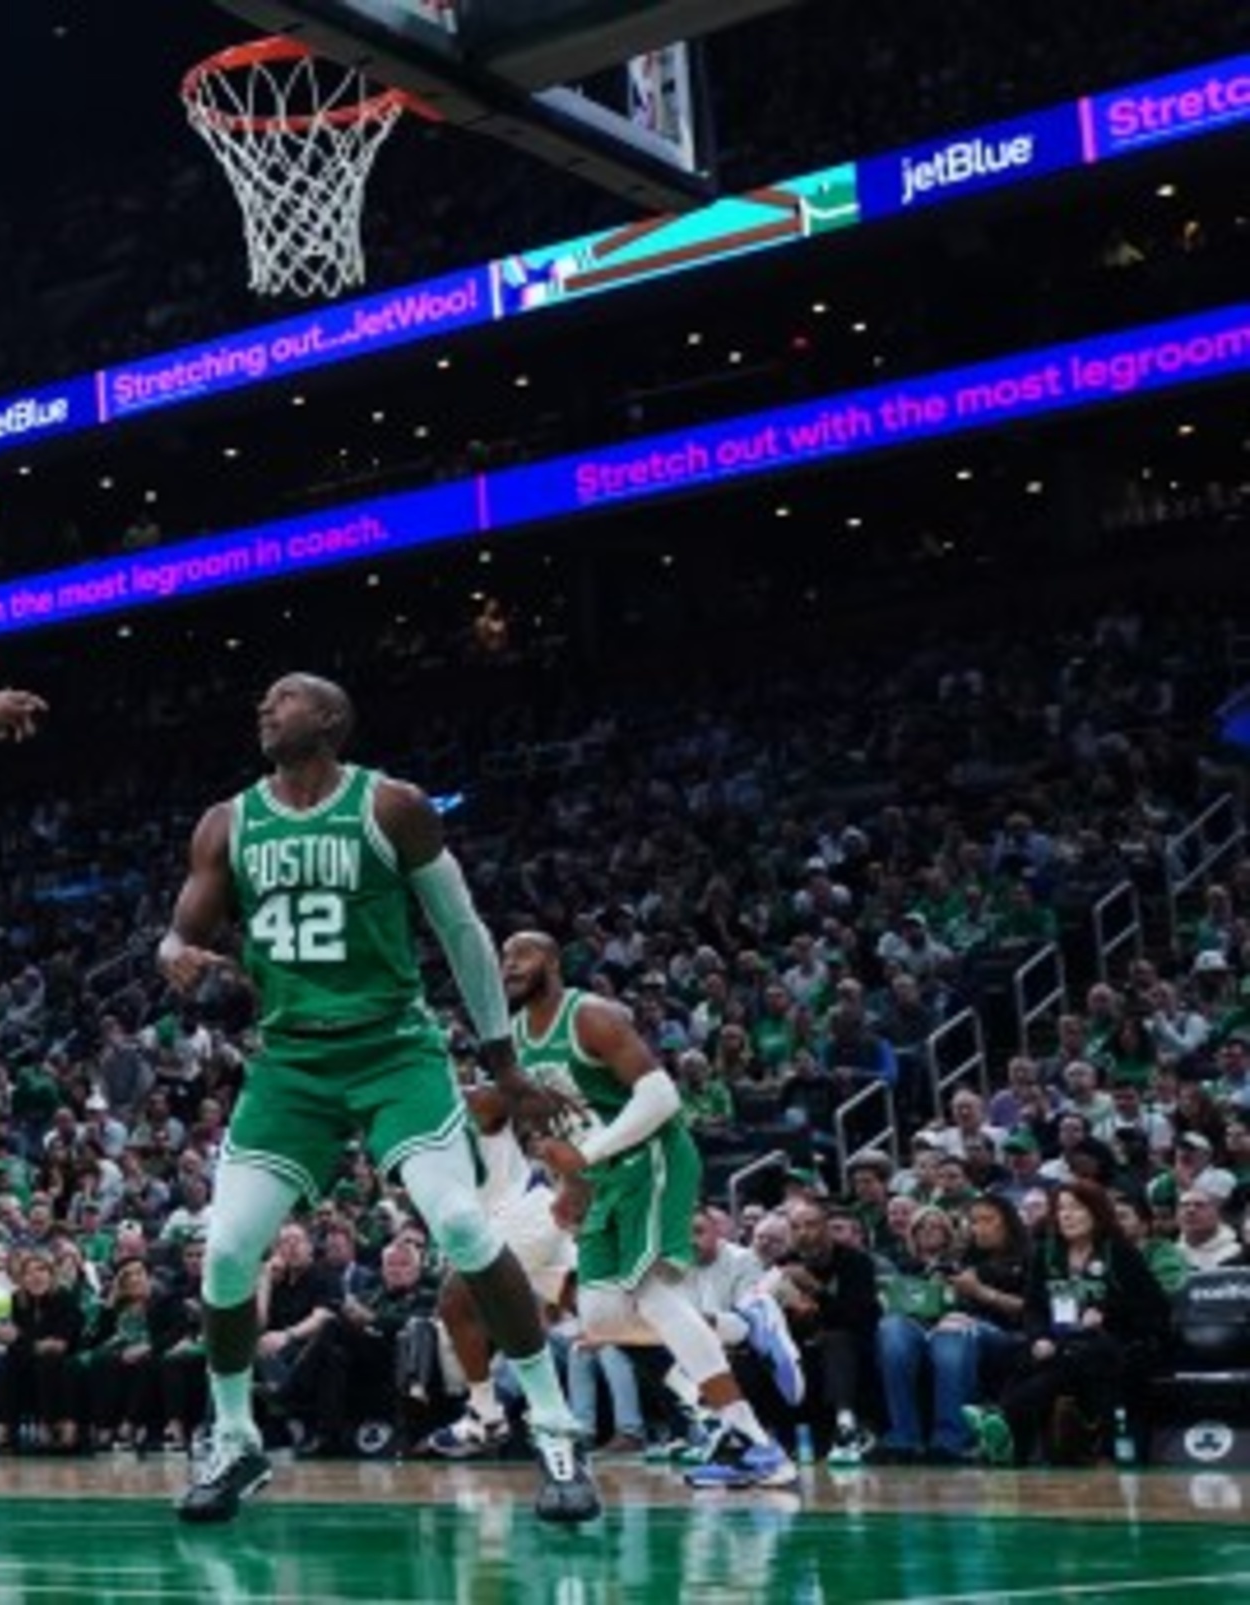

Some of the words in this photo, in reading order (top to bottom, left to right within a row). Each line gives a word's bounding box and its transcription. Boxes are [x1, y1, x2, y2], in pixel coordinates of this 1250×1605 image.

[901, 134, 1033, 204] jetBlue
[113, 346, 267, 404] Stretching
[576, 443, 708, 500] Stretch
[716, 427, 779, 466] out
[788, 407, 872, 450] with
[880, 396, 947, 431] the
[956, 366, 1061, 416] most
[1070, 328, 1250, 391] legroom
[10, 591, 53, 618] the
[57, 571, 127, 607] most
[131, 548, 250, 596] legroom
[255, 538, 282, 566] in
[287, 514, 388, 558] coach.
[243, 834, 360, 896] BOSTON
[250, 892, 347, 961] 42
